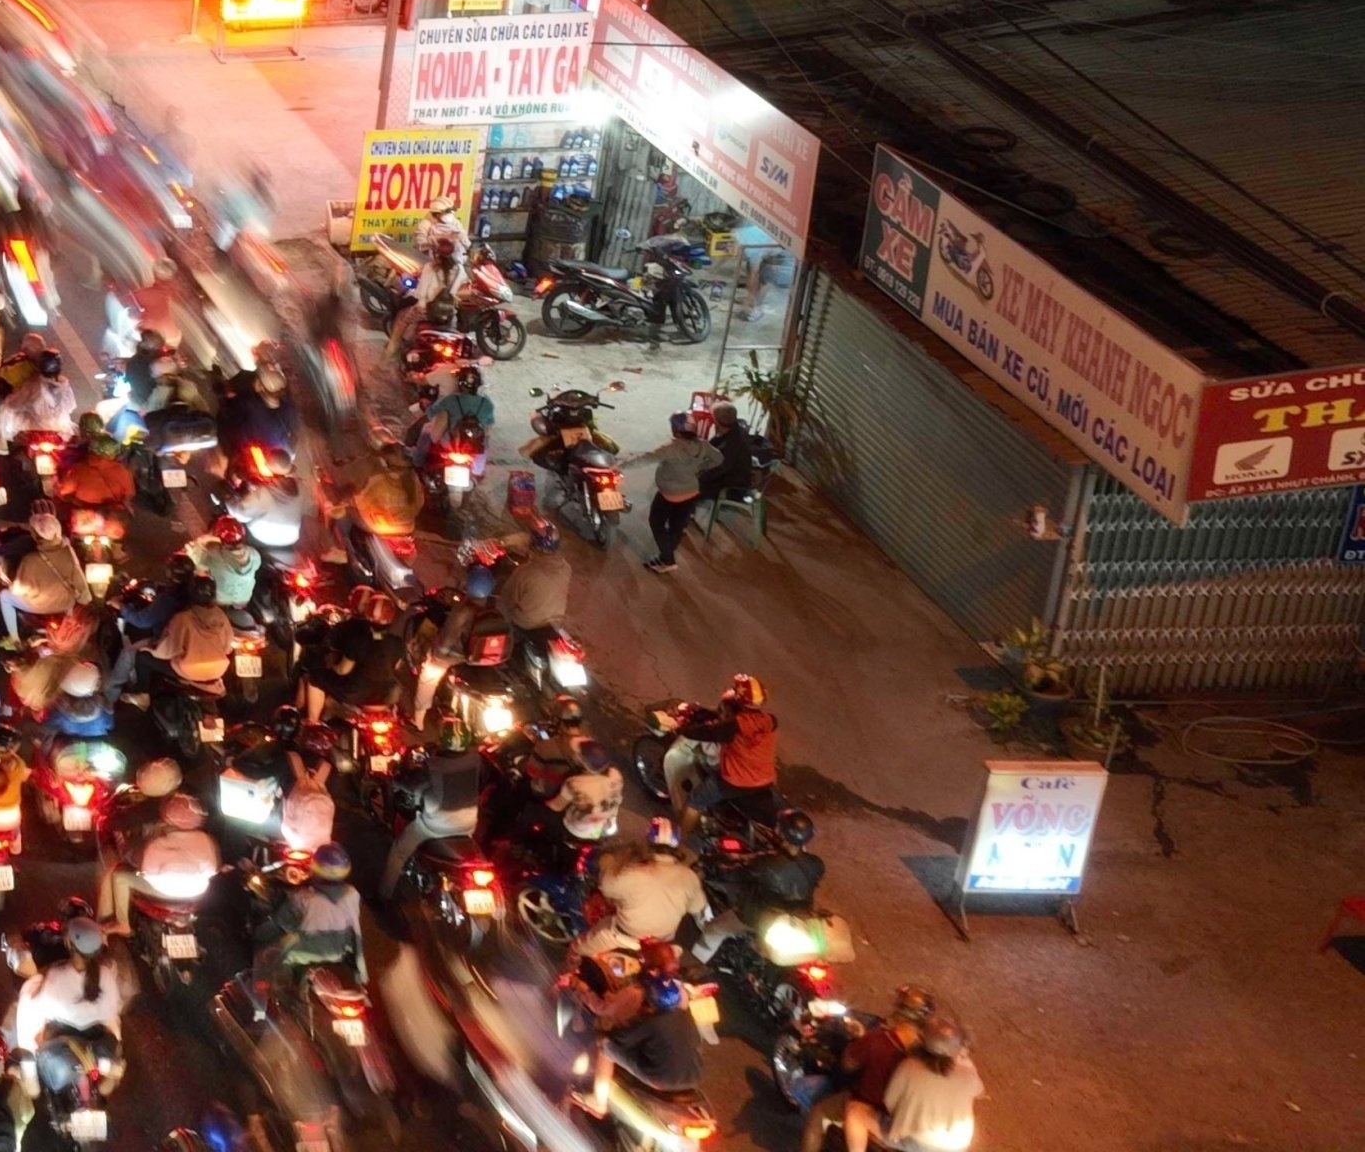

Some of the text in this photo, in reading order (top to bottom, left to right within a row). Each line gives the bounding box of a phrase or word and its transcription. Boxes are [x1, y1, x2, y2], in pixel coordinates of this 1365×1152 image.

[419, 20, 589, 45] CHUYÊN SỬA CHỮA CÁC LOẠI XE
[416, 49, 488, 101] HONDA
[508, 46, 550, 96] TAY
[552, 45, 580, 95] GA
[413, 107, 438, 118] THAY
[441, 103, 469, 118] NHỚT
[510, 101, 547, 114] KHÔNG
[364, 163, 463, 210] HONDA
[759, 155, 789, 189] SYM
[362, 218, 387, 228] THAY
[876, 219, 916, 283] XE
[996, 264, 1194, 450] XE MÁY KHÁNH NGỌC
[932, 291, 1176, 502] MUA BÁN XE CŨ, MỚI CÁC LOẠI
[1229, 380, 1296, 401] SỬA
[1224, 468, 1279, 481] HONDA
